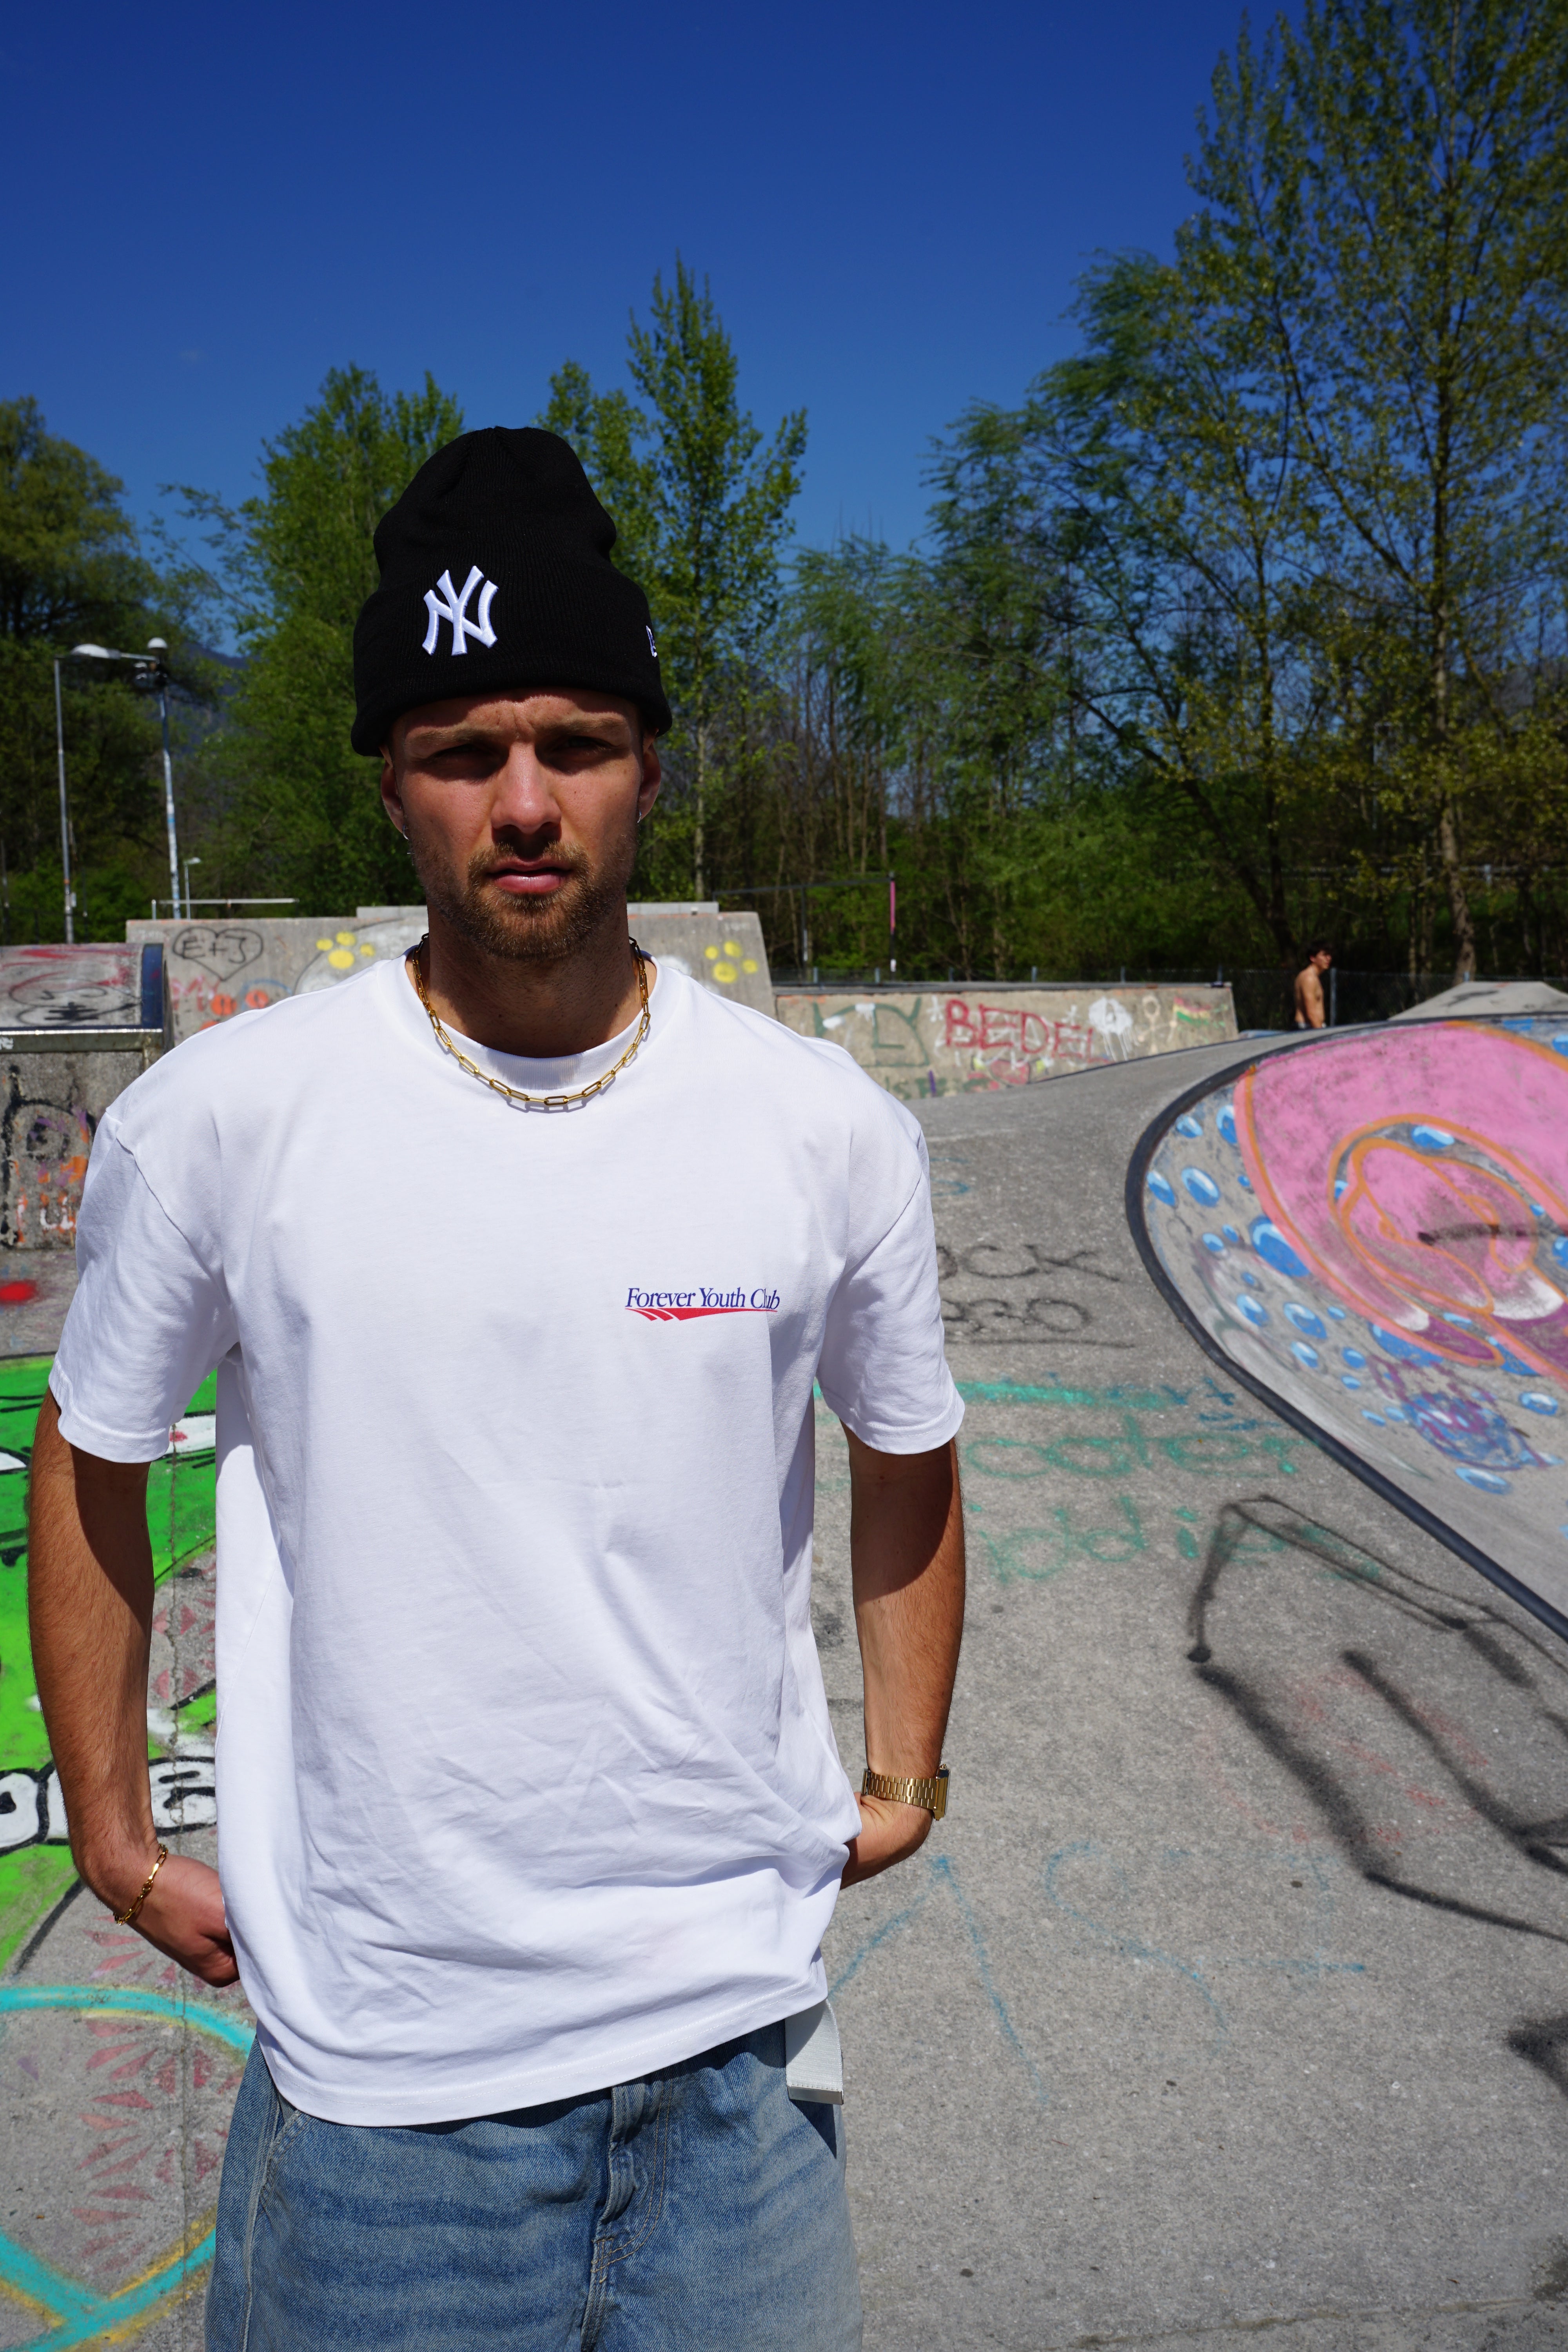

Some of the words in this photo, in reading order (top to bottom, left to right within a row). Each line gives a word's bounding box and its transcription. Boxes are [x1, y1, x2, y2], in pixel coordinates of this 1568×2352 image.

[422, 565, 499, 656] NY
[625, 1287, 696, 1307] Forever
[699, 1287, 745, 1307] Youth
[751, 1288, 780, 1310] Club
